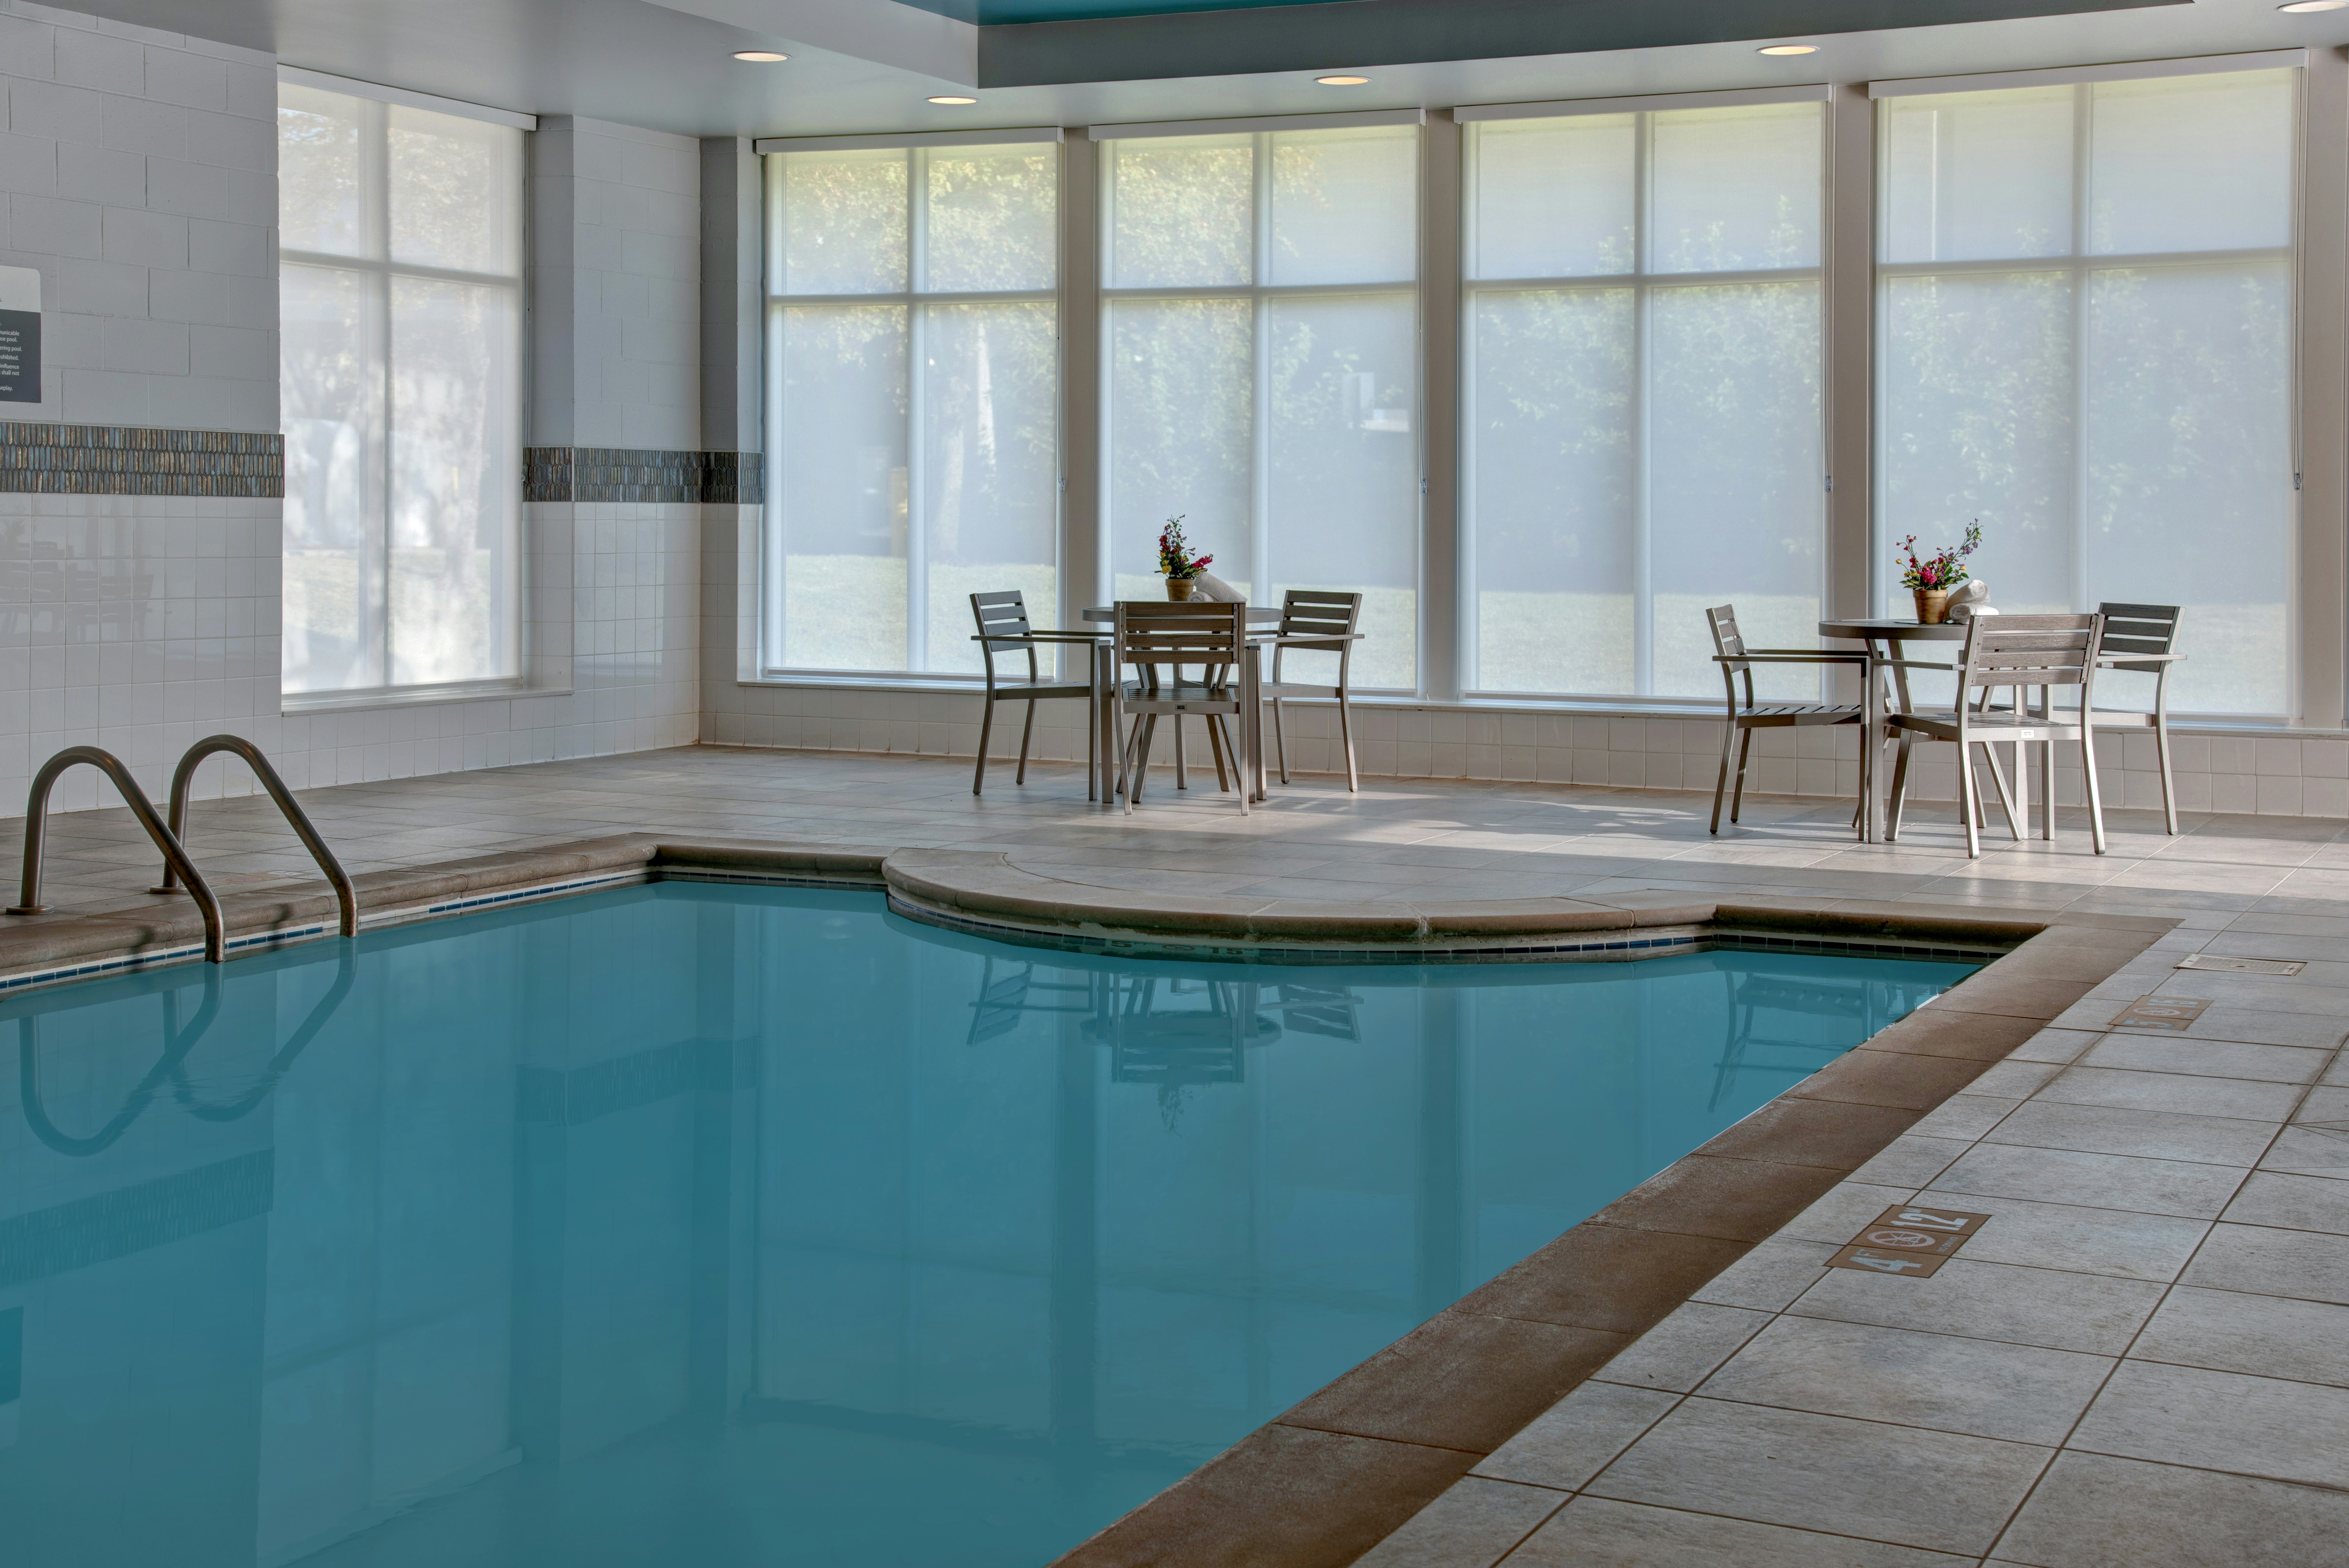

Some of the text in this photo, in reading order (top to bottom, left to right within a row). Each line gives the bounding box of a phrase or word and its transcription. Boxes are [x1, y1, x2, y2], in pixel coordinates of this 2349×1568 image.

[2122, 1019, 2174, 1028] 5
[1890, 1213, 1969, 1231] 1.2
[1850, 1248, 1923, 1271] 4 FT
